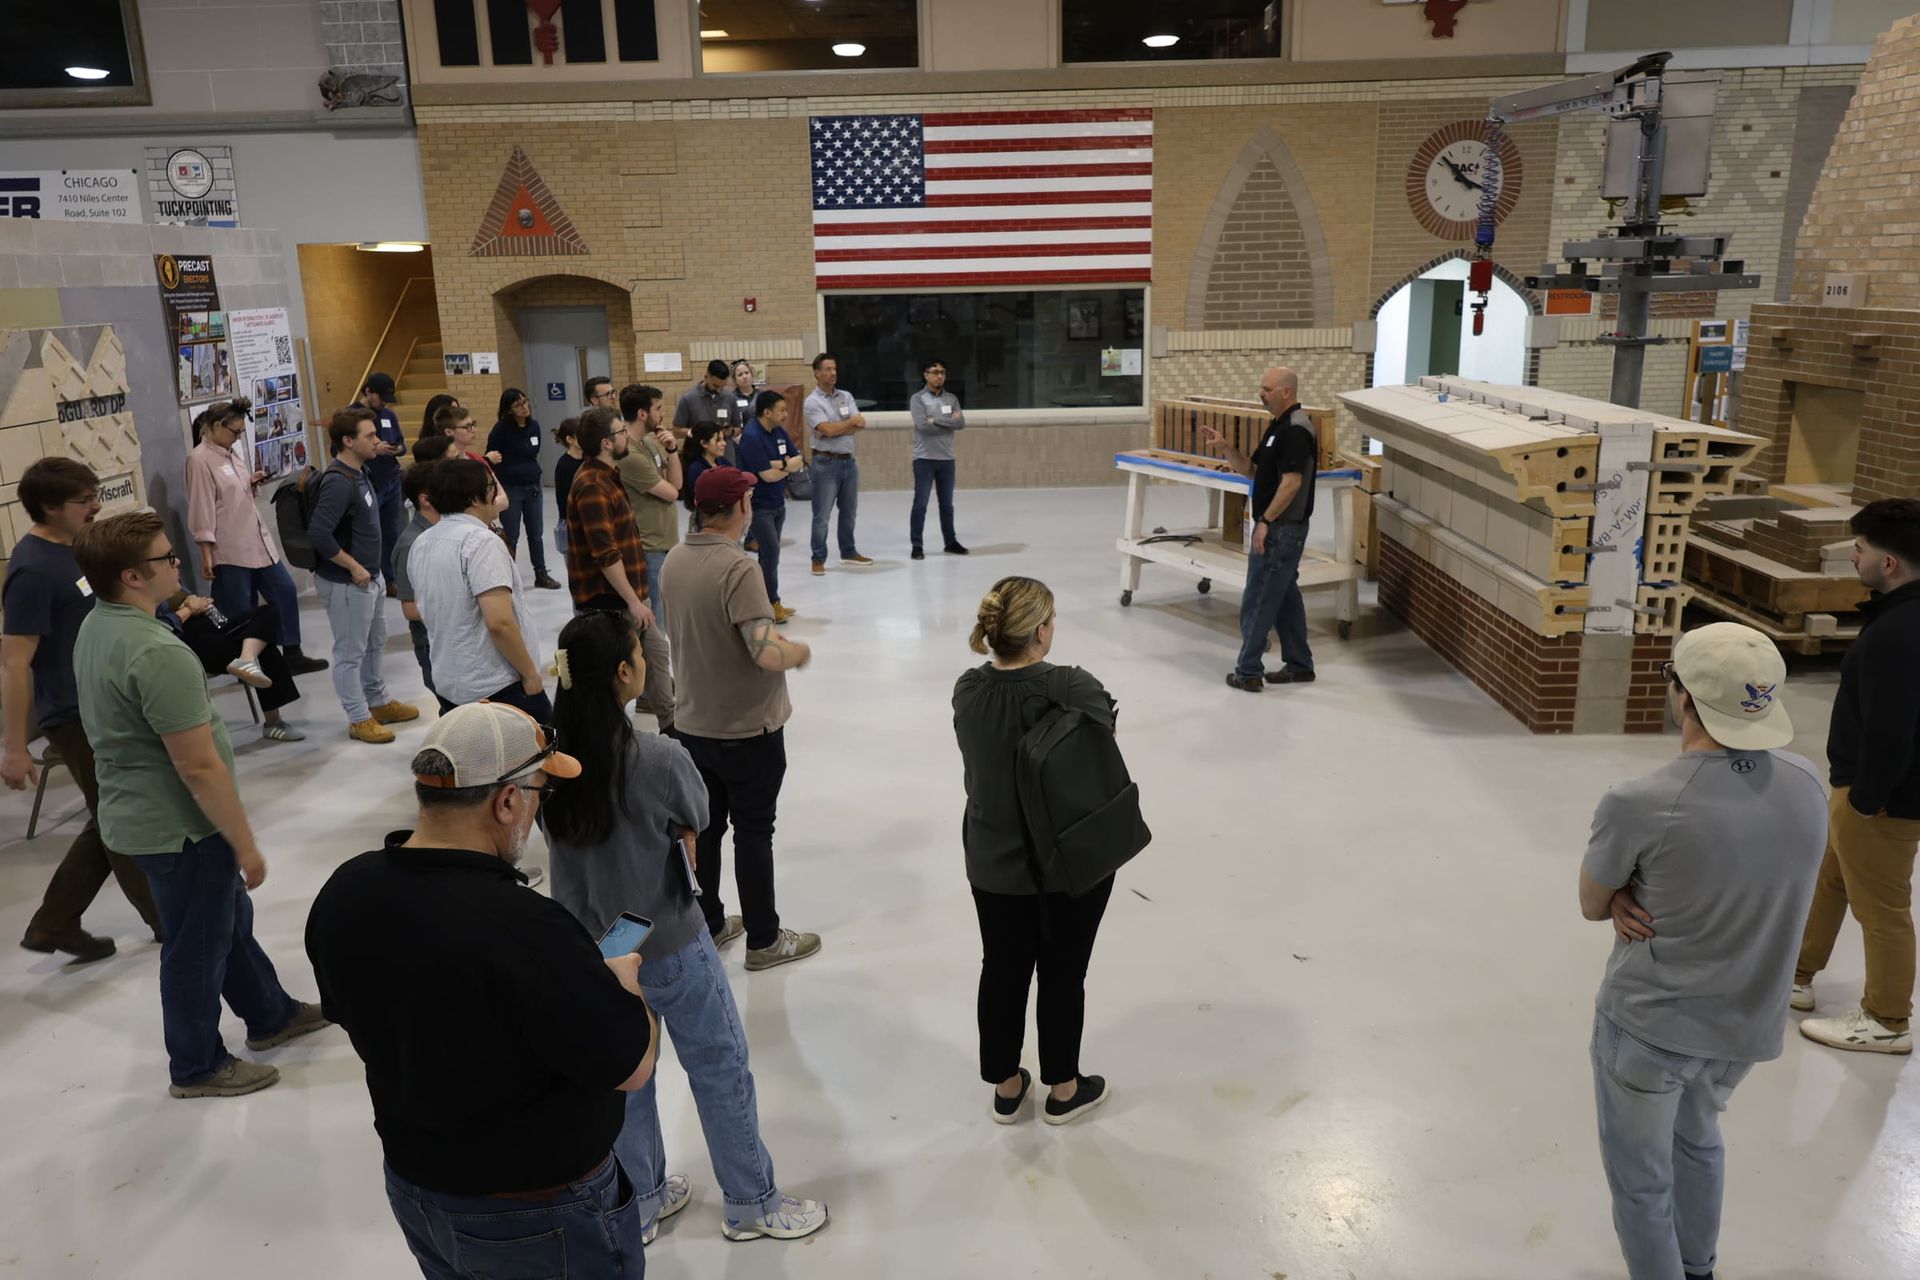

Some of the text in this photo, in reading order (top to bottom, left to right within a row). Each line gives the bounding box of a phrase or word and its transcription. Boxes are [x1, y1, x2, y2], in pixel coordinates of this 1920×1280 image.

[1462, 145, 1472, 154] 12
[64, 176, 118, 188] CHICAGO
[58, 193, 129, 203] 7410 Niles Center
[88, 208, 110, 218] Suite
[111, 208, 127, 217] 102
[157, 200, 232, 217] TUCKPOINTING
[178, 260, 210, 272] PRECAST
[1826, 285, 1848, 296] 2106
